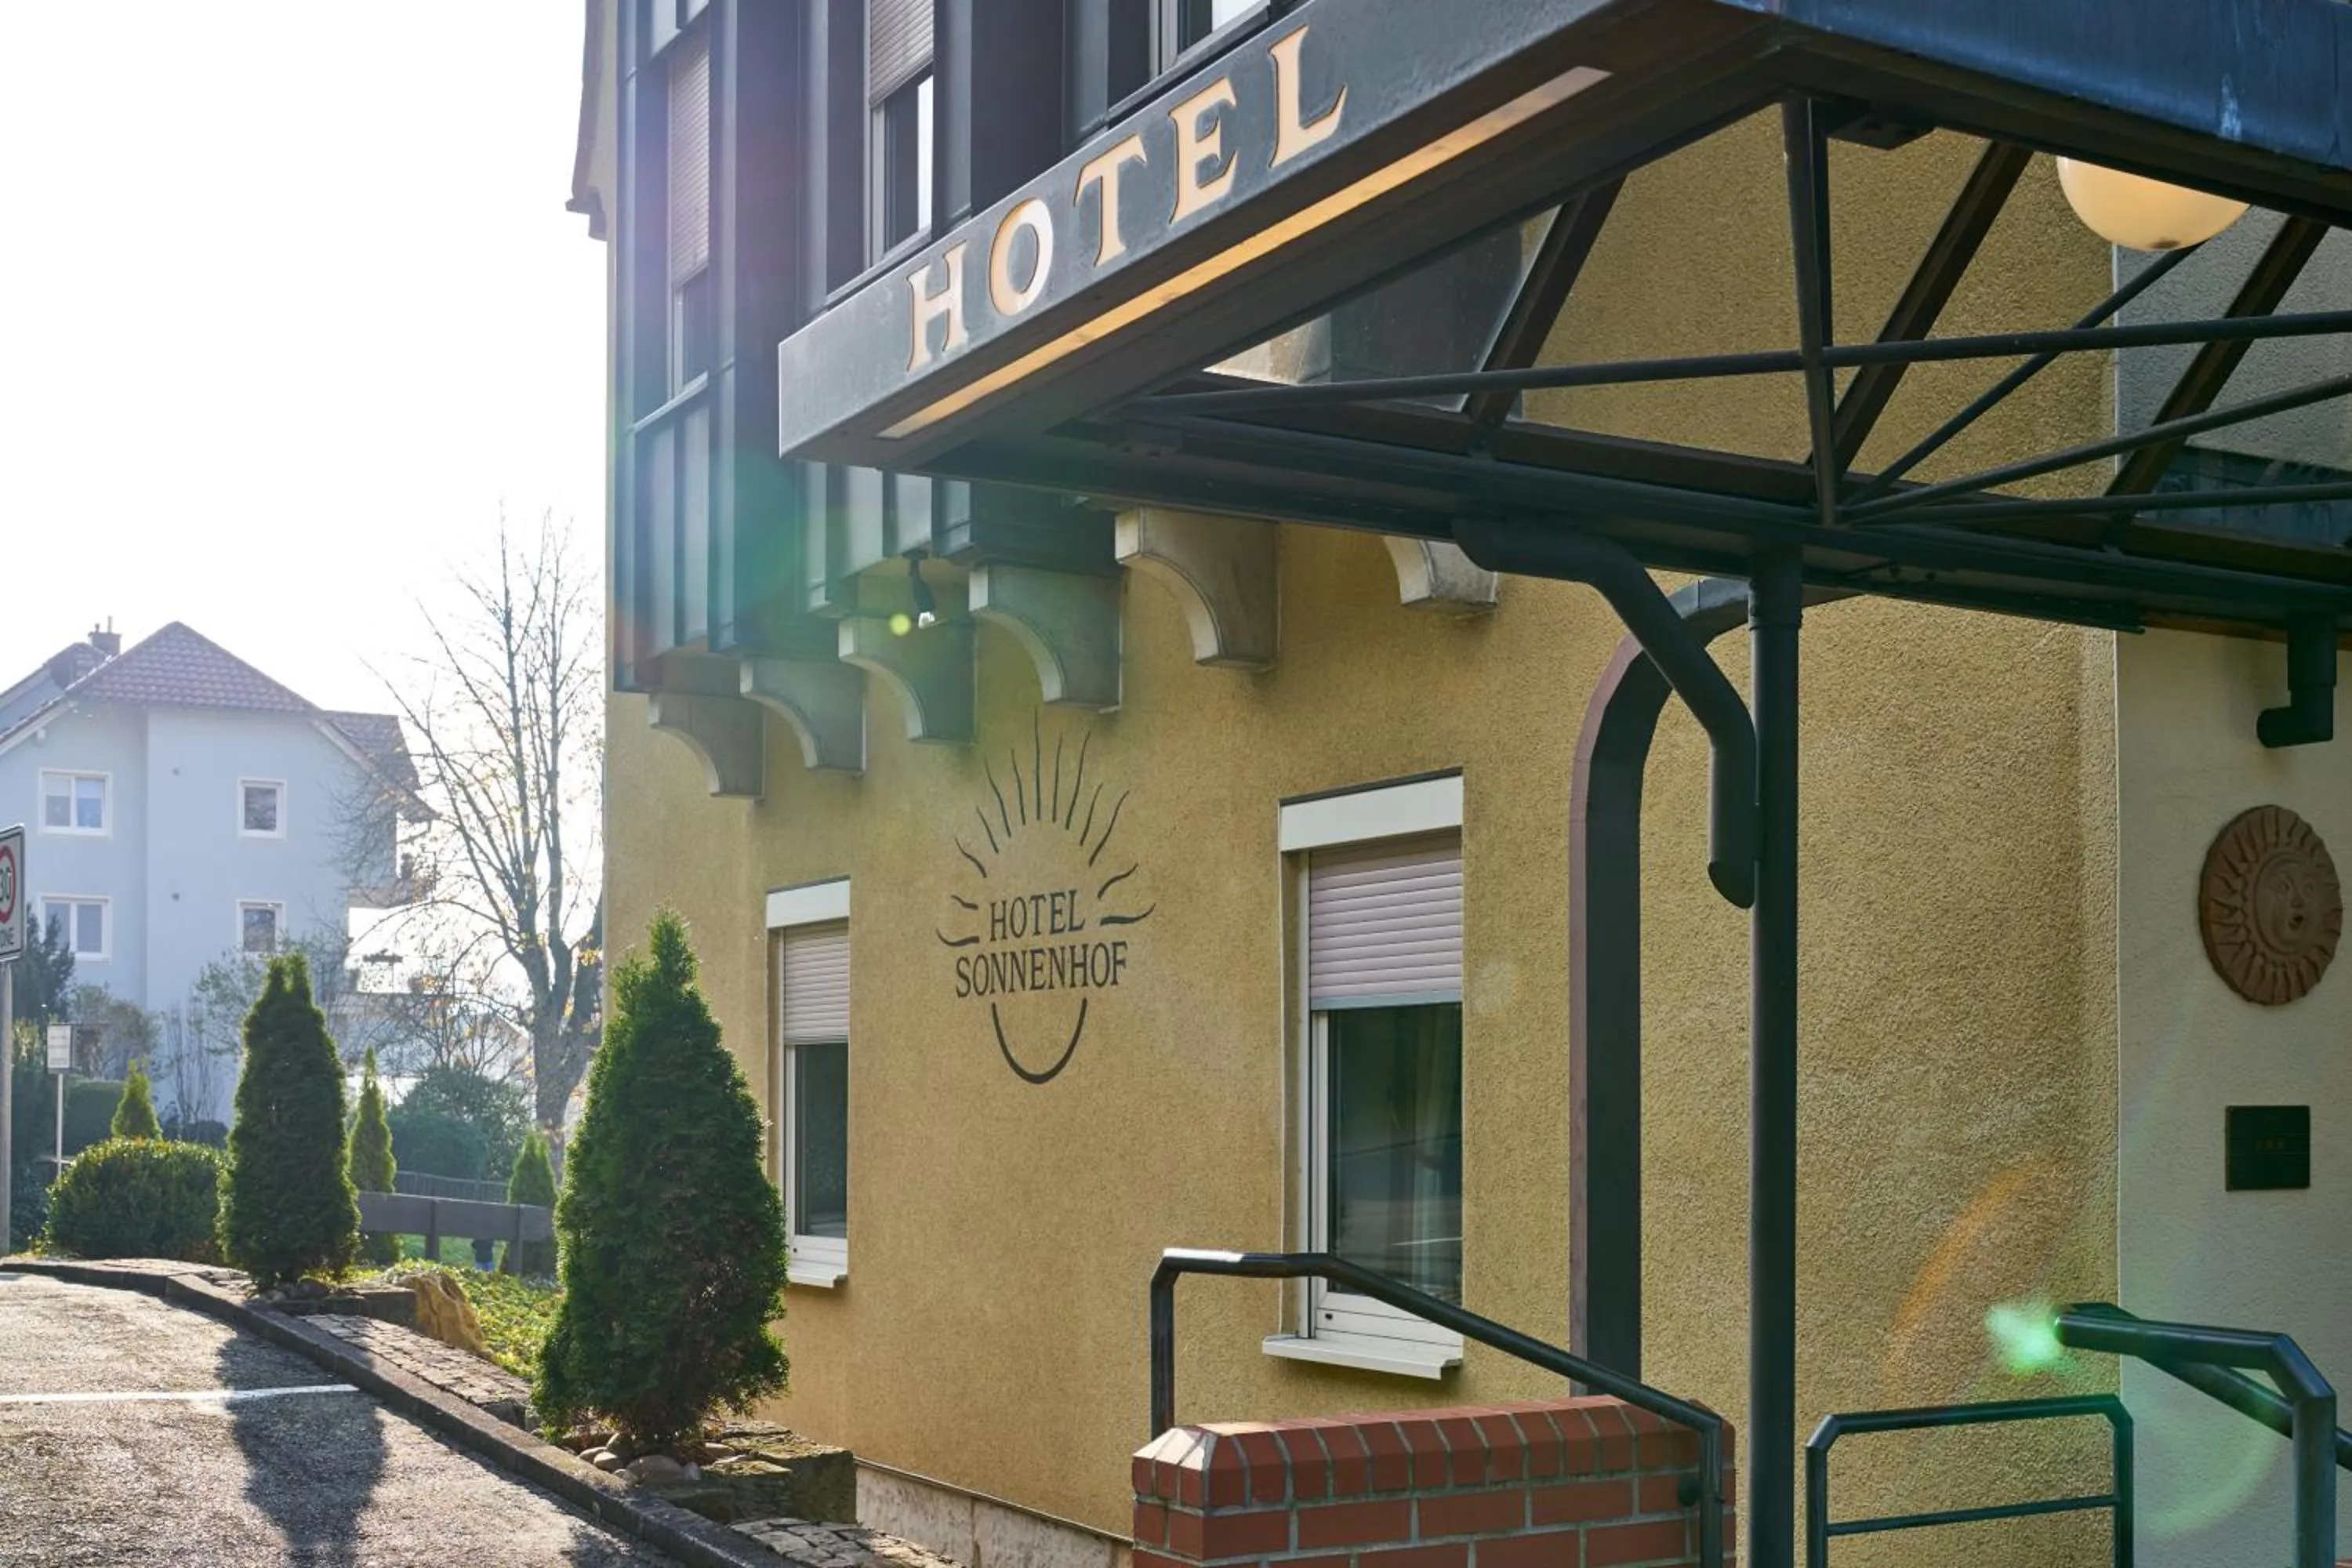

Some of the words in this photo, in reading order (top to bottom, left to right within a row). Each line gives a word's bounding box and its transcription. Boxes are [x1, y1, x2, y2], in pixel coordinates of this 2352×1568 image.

[906, 24, 1347, 373] HOTEL
[990, 890, 1085, 942] HOTEL
[956, 942, 1127, 997] SONNENHOF
